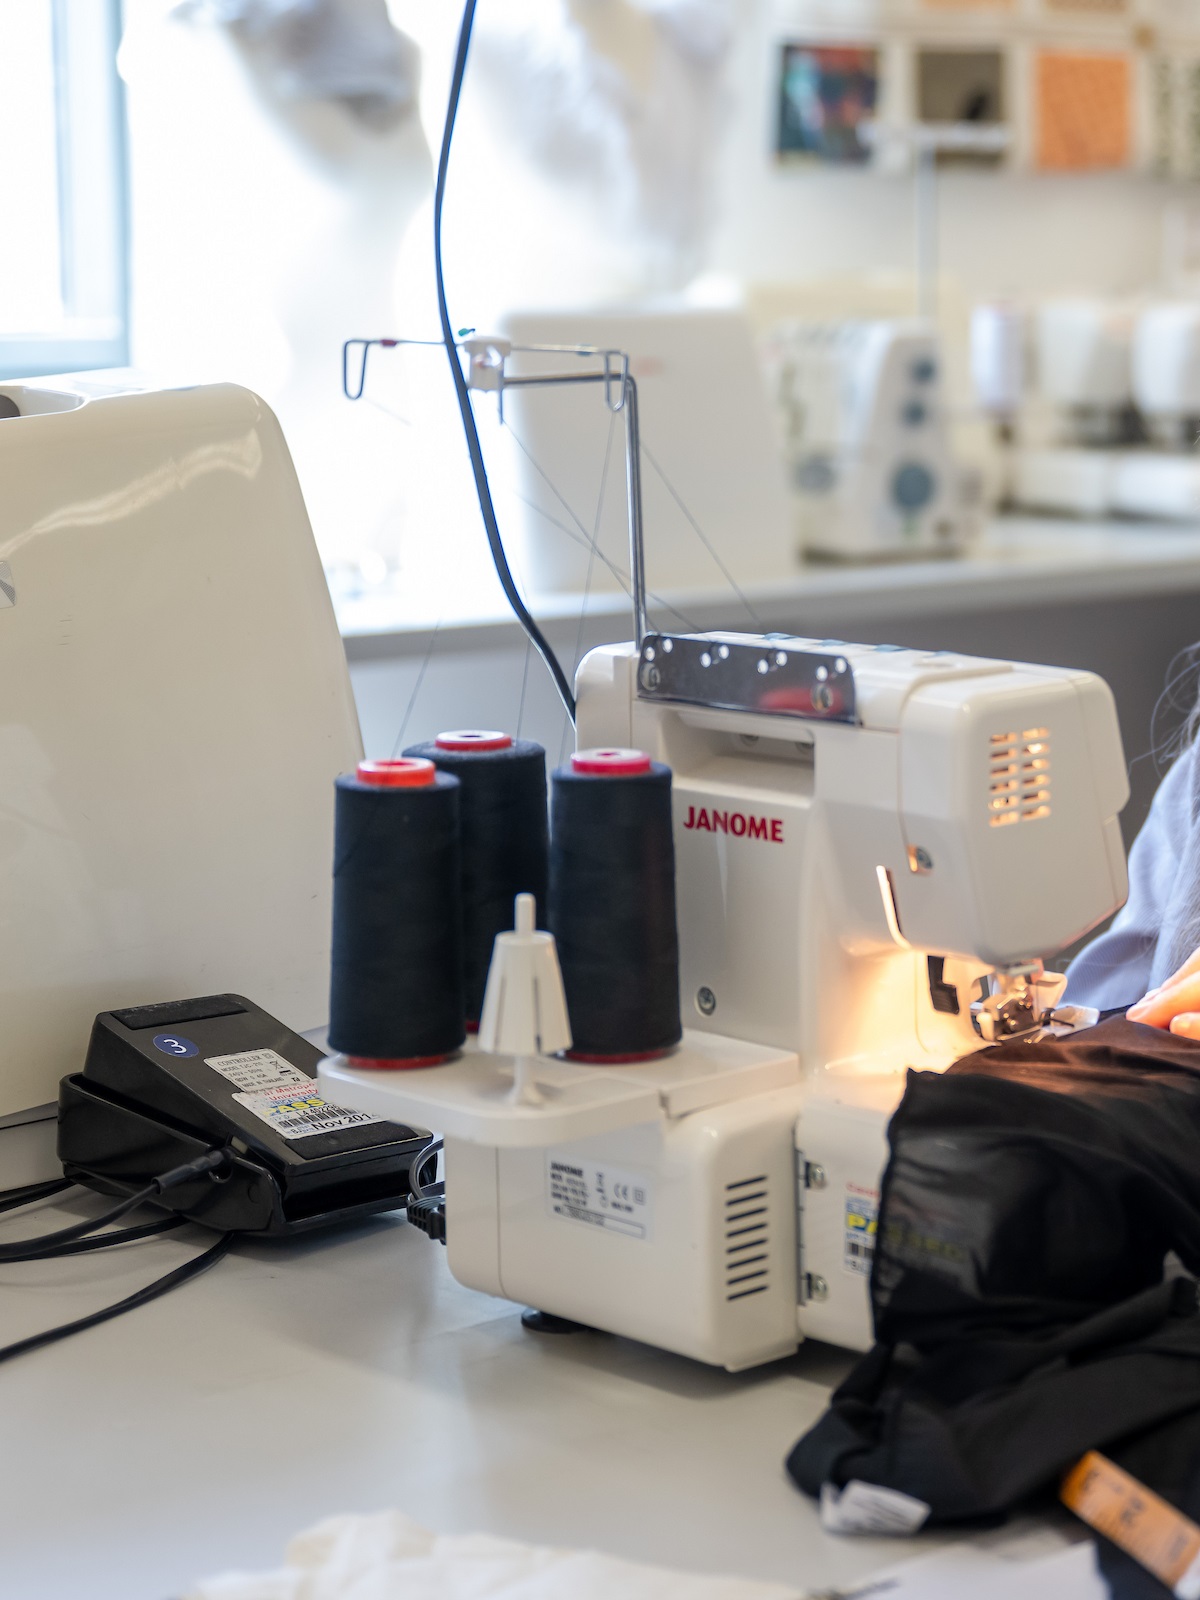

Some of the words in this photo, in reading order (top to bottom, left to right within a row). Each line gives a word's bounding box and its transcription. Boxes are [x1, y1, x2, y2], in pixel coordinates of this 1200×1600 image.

[683, 805, 785, 843] JANOME
[163, 1038, 187, 1053] 3
[217, 1055, 262, 1066] CONTROLLER
[269, 1089, 318, 1101] University
[275, 1082, 315, 1094] Metropo
[263, 1098, 326, 1117] PASS
[311, 1119, 342, 1130] Nov
[343, 1113, 378, 1124] 201
